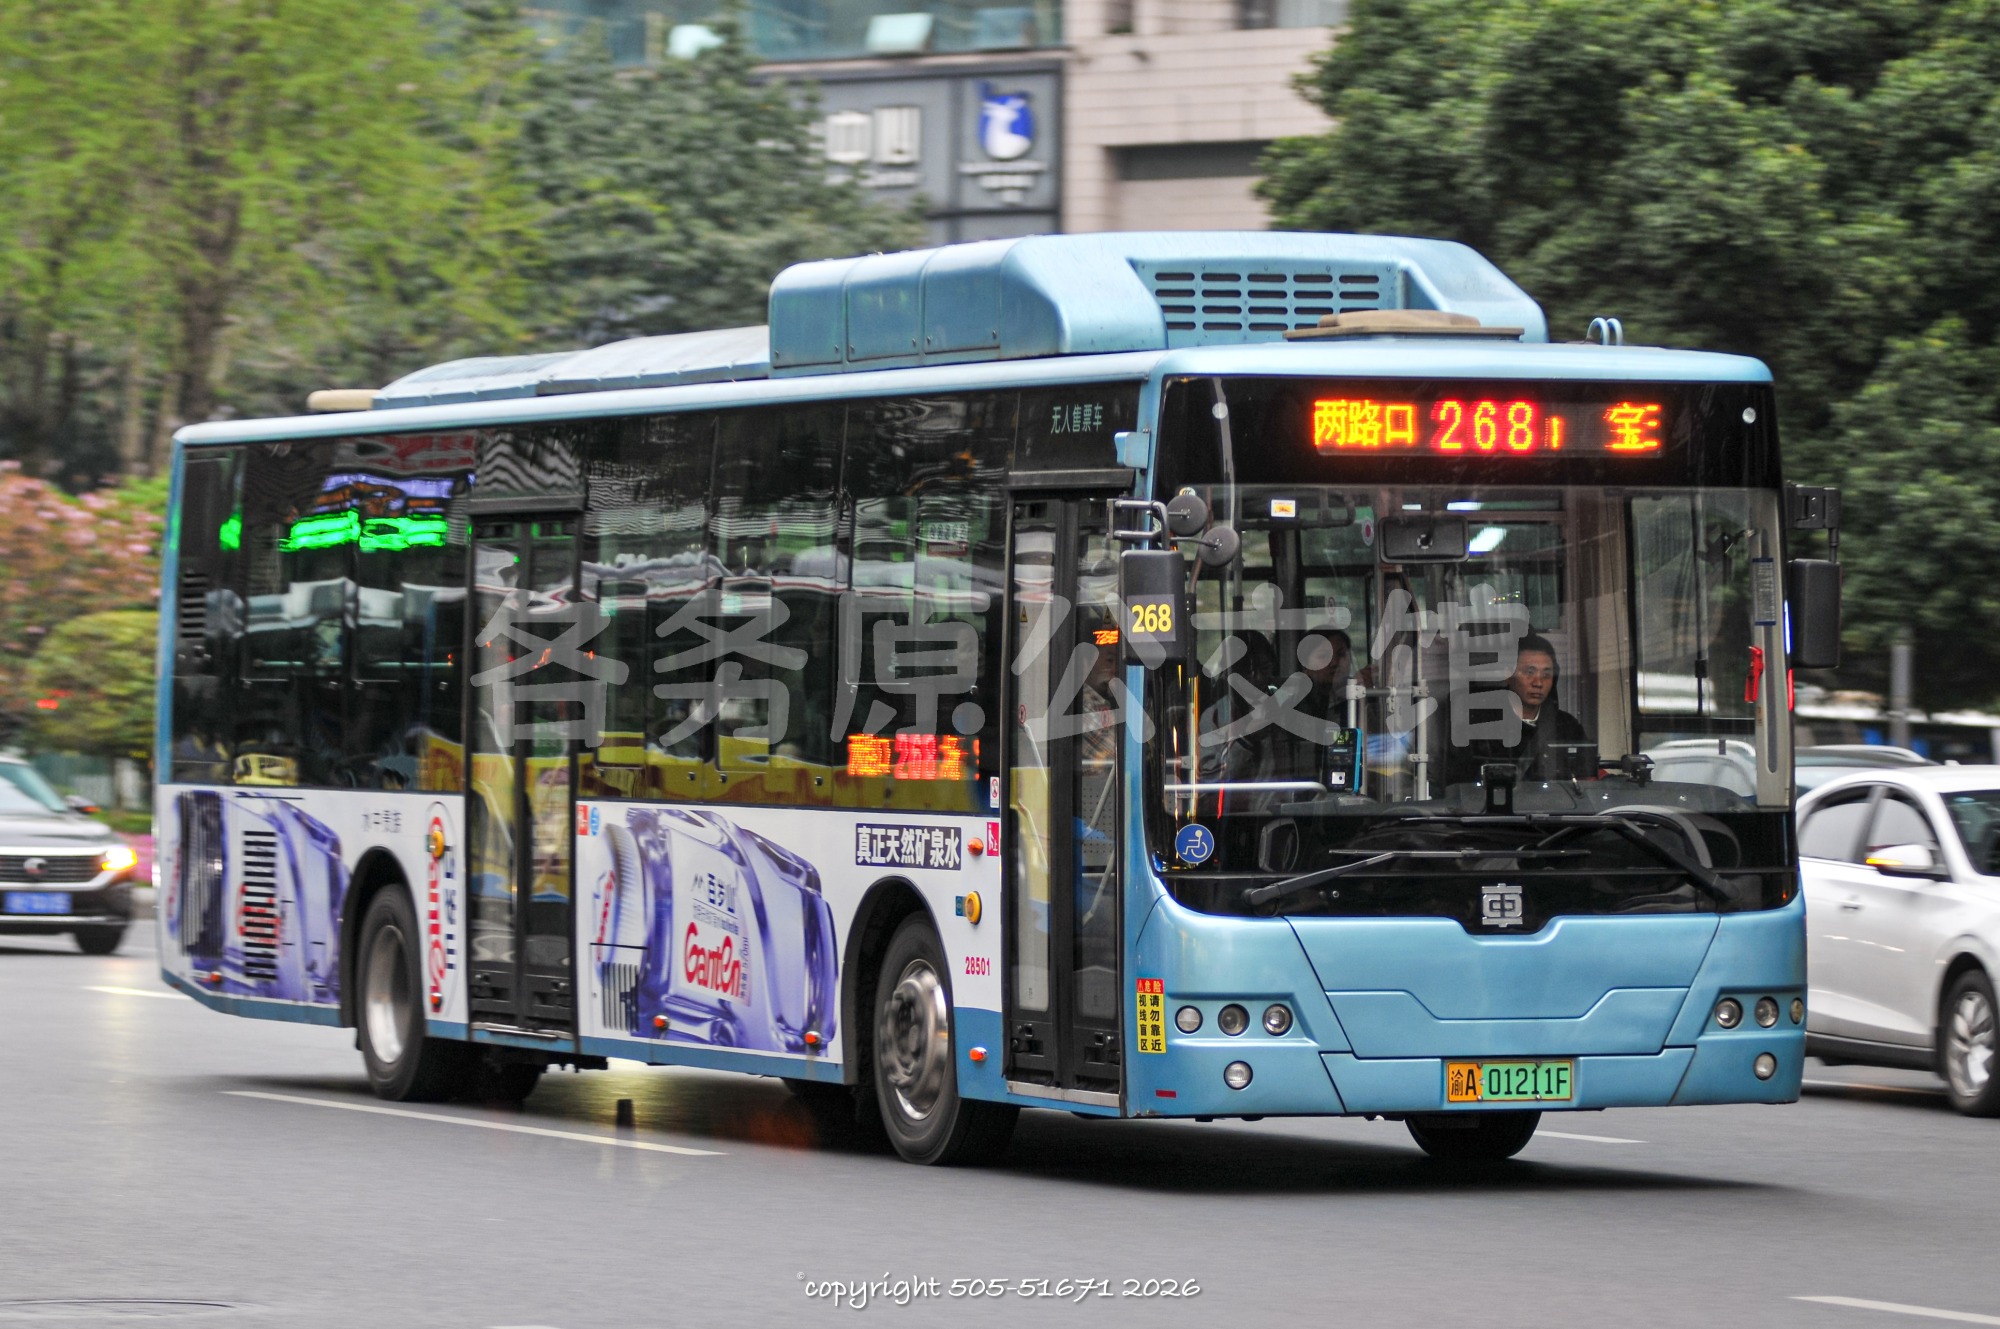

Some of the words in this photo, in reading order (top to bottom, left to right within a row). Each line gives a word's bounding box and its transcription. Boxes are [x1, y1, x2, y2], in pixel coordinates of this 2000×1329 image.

[1051, 402, 1103, 434] 无人售票车
[1314, 400, 1413, 446] 两路口
[1437, 400, 1533, 450] 268
[1131, 603, 1172, 633] 268
[857, 826, 960, 868] 真正天然矿泉水
[684, 921, 741, 997] Ganten
[965, 956, 991, 976] 28501
[1139, 994, 1148, 1051] 视线盲区
[1150, 994, 1162, 1051] 请勿靠近
[1488, 1067, 1568, 1095] 01211F
